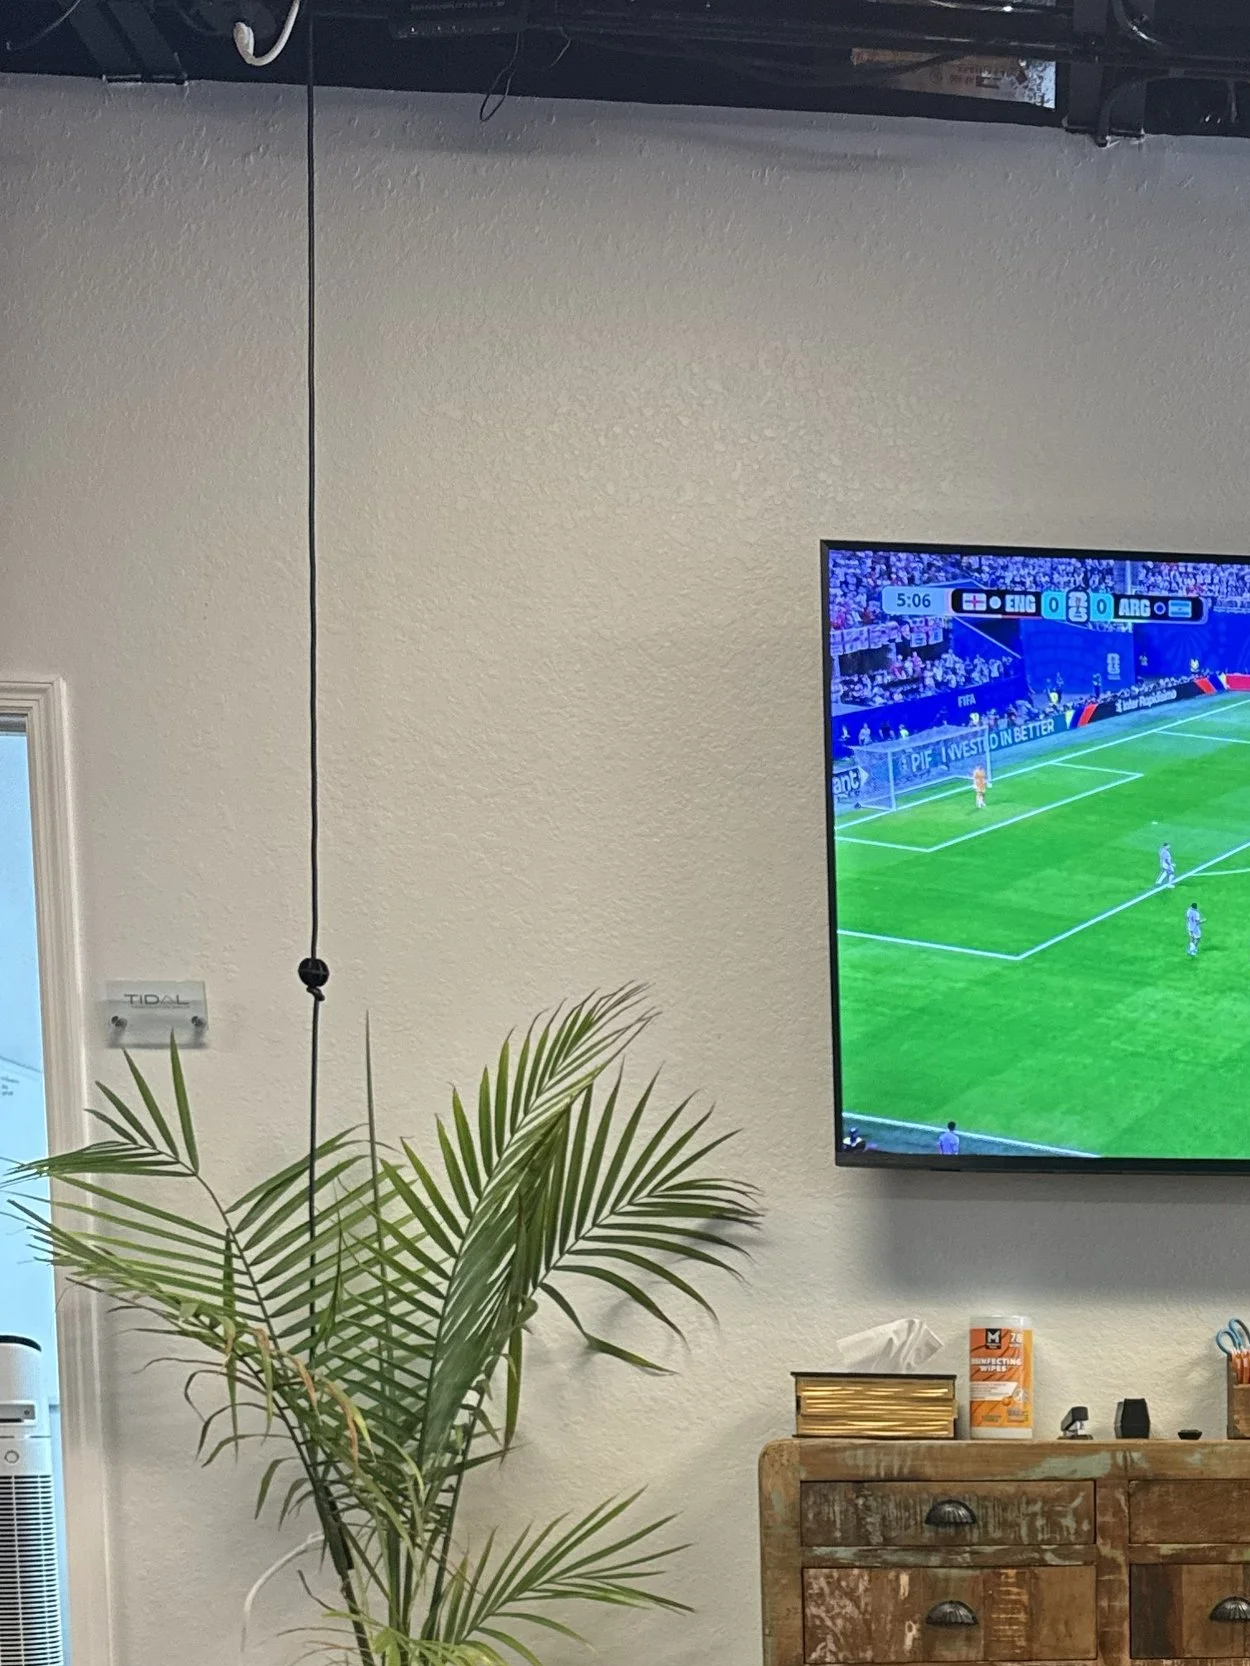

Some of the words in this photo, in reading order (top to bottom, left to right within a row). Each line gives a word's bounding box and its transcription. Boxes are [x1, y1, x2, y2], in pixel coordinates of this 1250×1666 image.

[896, 592, 931, 608] 5:06
[1004, 594, 1036, 613] ENG
[1048, 596, 1059, 613] 0
[1096, 598, 1107, 615] 0
[1118, 598, 1151, 617] ARG
[957, 693, 977, 708] FIFA
[911, 749, 933, 773] PIF
[941, 732, 998, 763] INVESTD
[1000, 728, 1013, 747] IN
[1013, 718, 1055, 743] BETTER
[124, 993, 190, 1006] TIDAL
[980, 1365, 1007, 1373] WIPES
